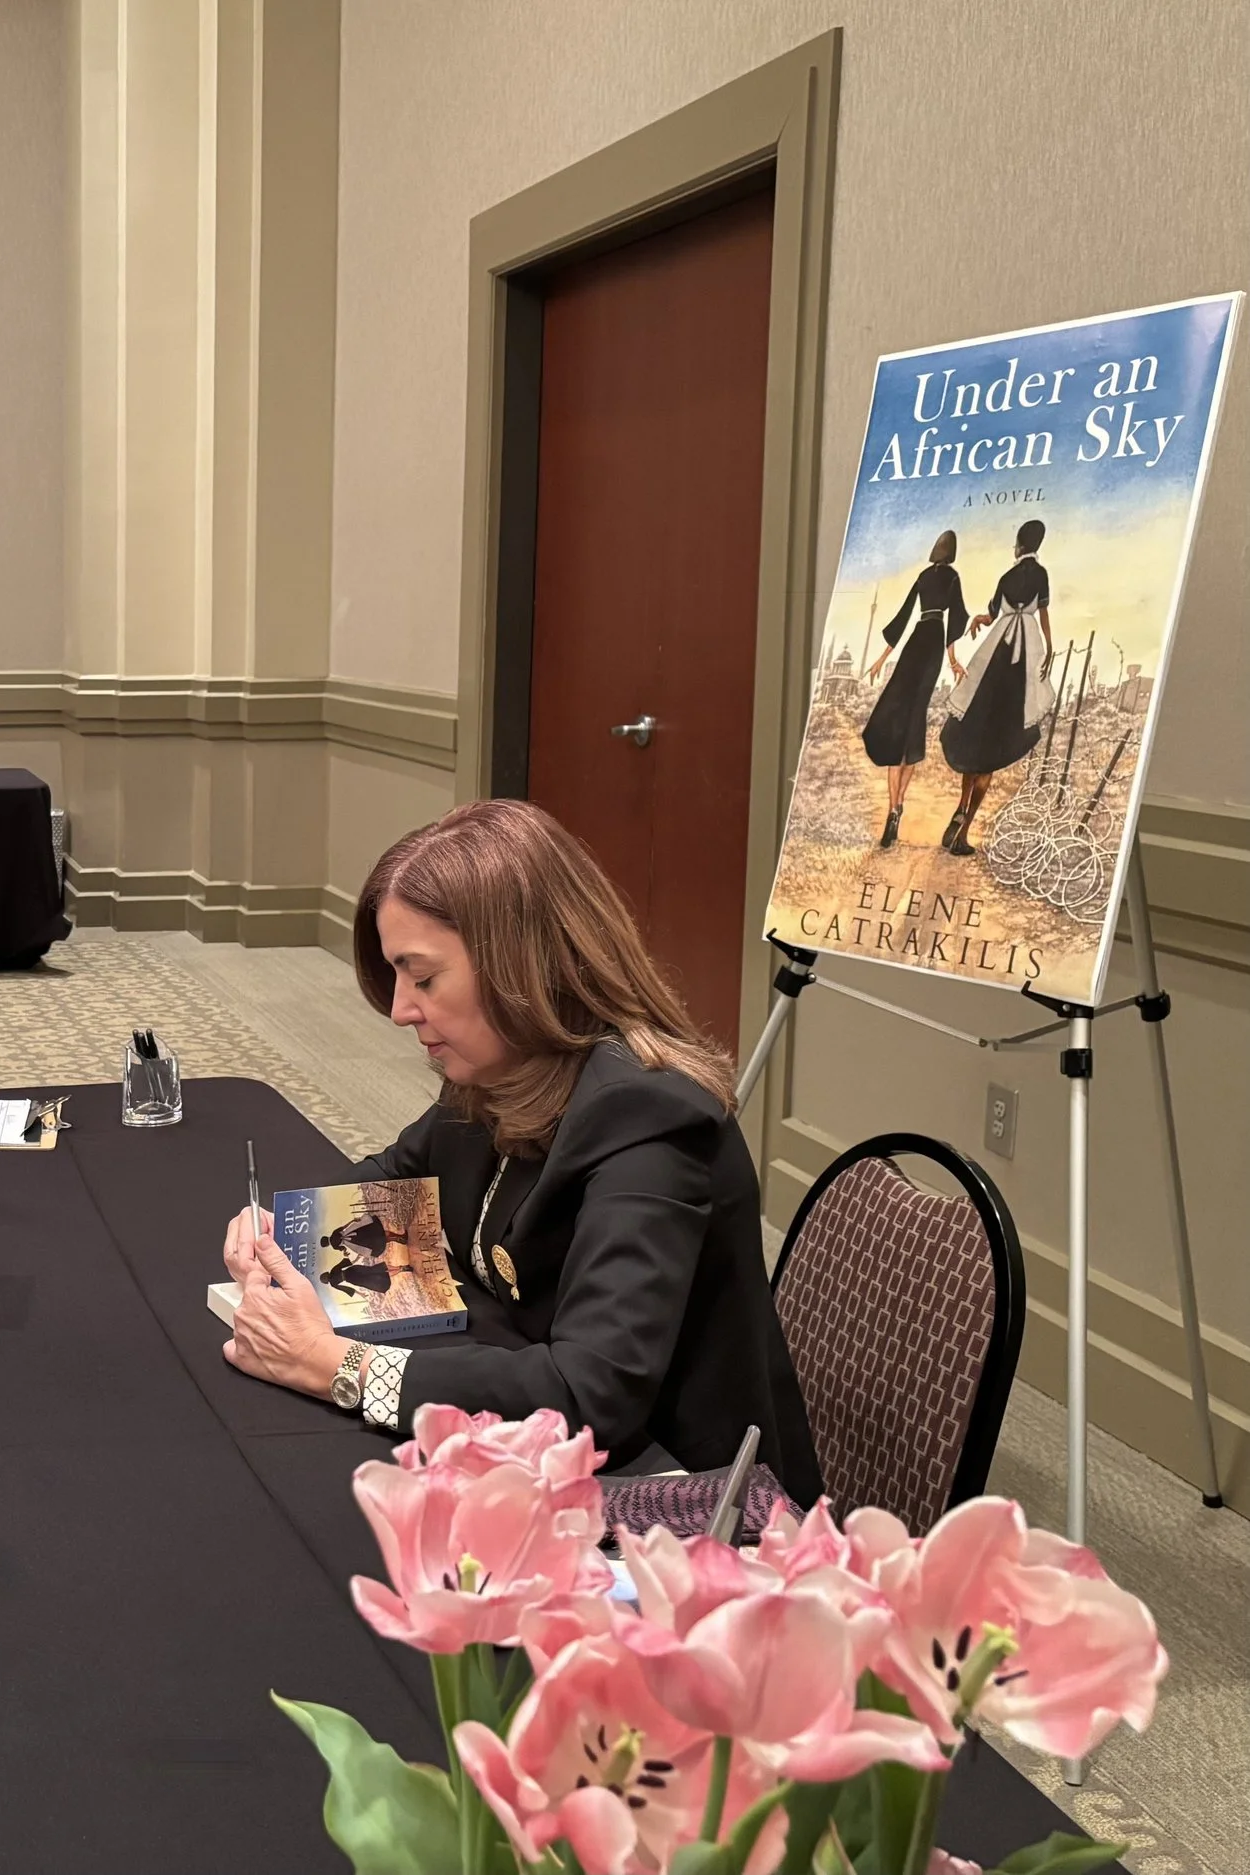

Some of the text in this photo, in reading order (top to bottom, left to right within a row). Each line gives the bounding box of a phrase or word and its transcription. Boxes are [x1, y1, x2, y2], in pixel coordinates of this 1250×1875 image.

[912, 355, 1159, 424] Under an
[868, 400, 1186, 483] African Sky
[962, 487, 1047, 508] A NOVEL
[857, 882, 985, 929] ELENE
[800, 908, 1045, 980] CATRAKILIS
[284, 1208, 295, 1235] an
[294, 1195, 313, 1234] Sky
[417, 1218, 434, 1275] ELENE
[426, 1192, 453, 1297] CATRAKILIS
